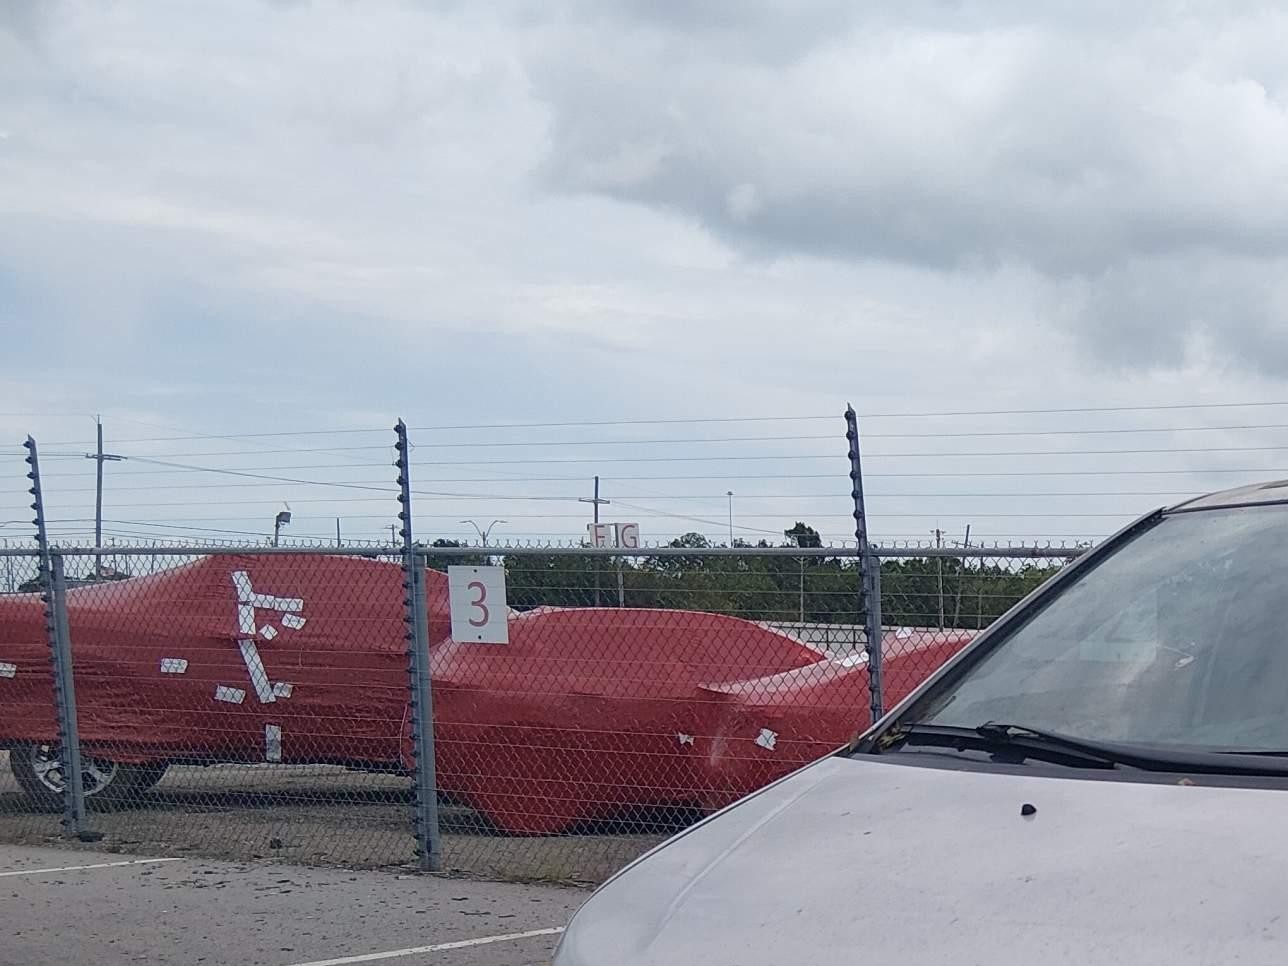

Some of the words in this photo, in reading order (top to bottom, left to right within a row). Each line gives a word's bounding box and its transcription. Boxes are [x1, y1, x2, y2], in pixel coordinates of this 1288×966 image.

[594, 524, 606, 548] F
[621, 524, 638, 549] G
[467, 581, 489, 627] 3
